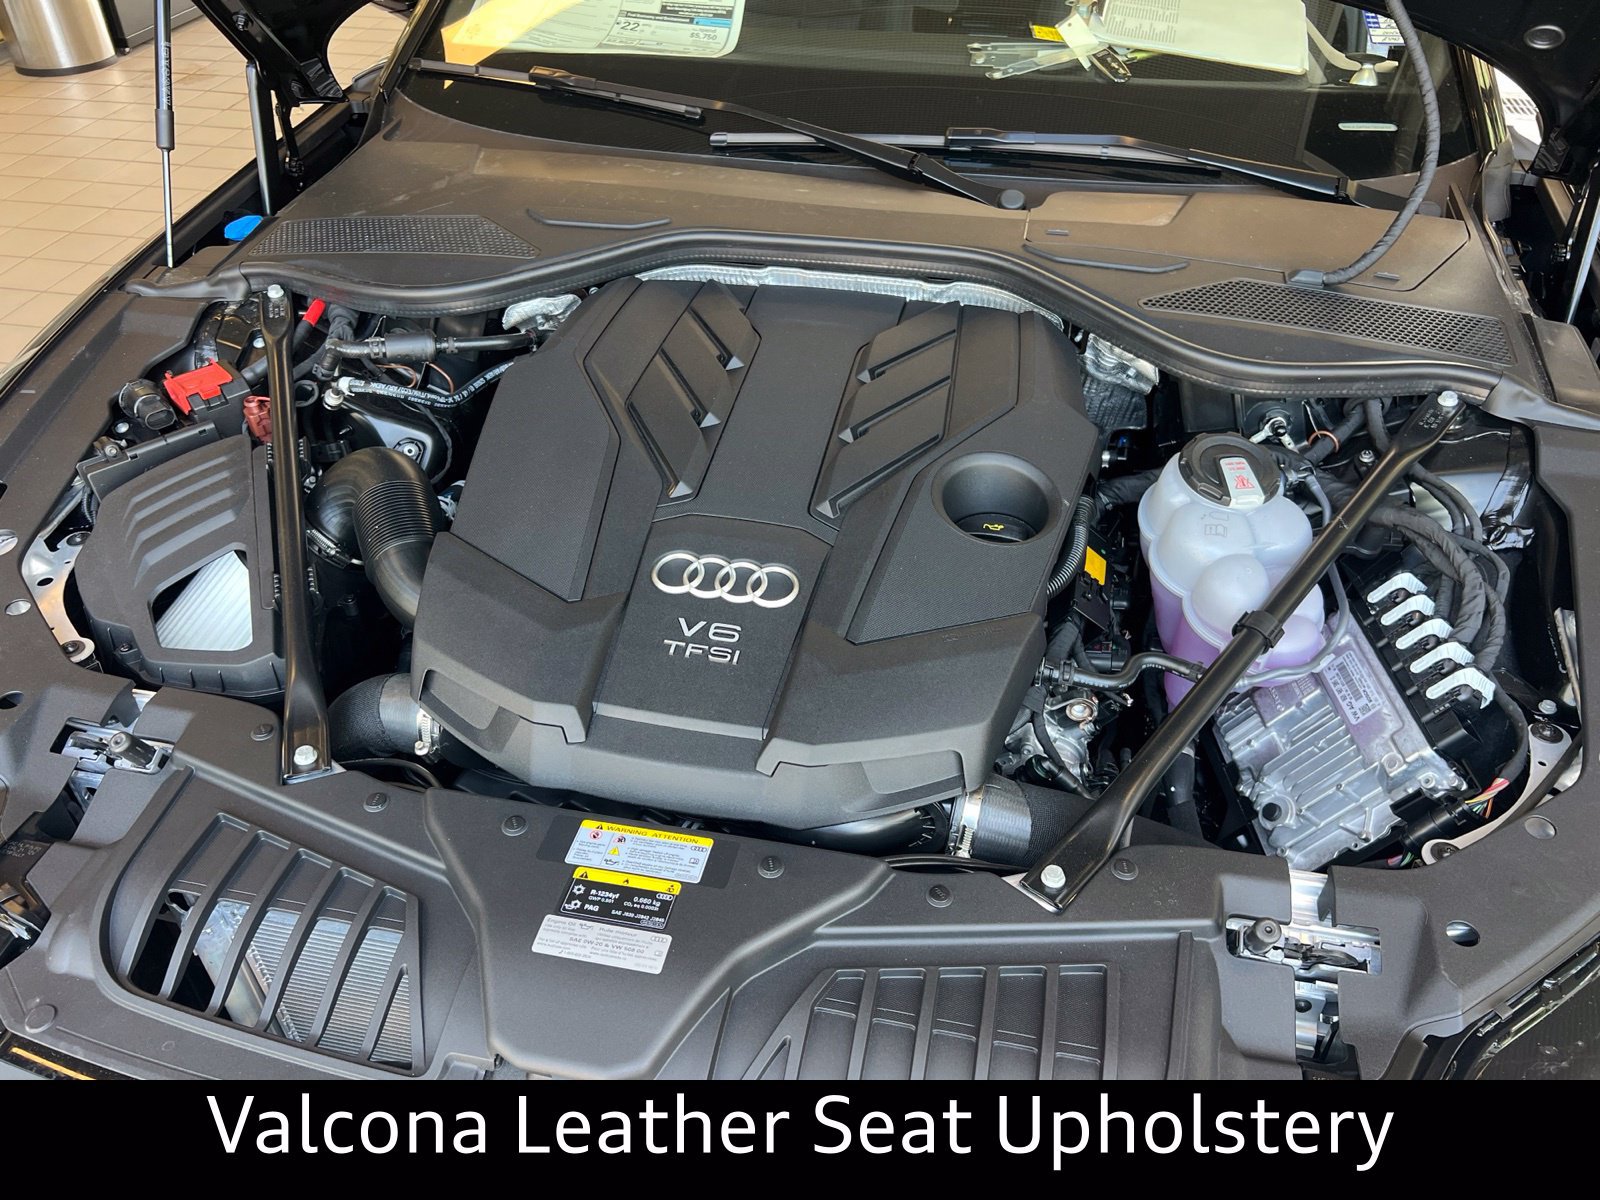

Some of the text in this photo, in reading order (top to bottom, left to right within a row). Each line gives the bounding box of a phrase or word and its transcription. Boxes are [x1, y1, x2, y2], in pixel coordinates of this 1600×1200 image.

[619, 21, 640, 32] 22
[678, 617, 742, 643] V6
[663, 639, 741, 665] TFSI
[607, 825, 648, 837] WARNING
[652, 833, 699, 844] ATTENTION
[590, 889, 620, 899] R-1234yf
[584, 903, 600, 912] PAG
[652, 899, 661, 907] kg
